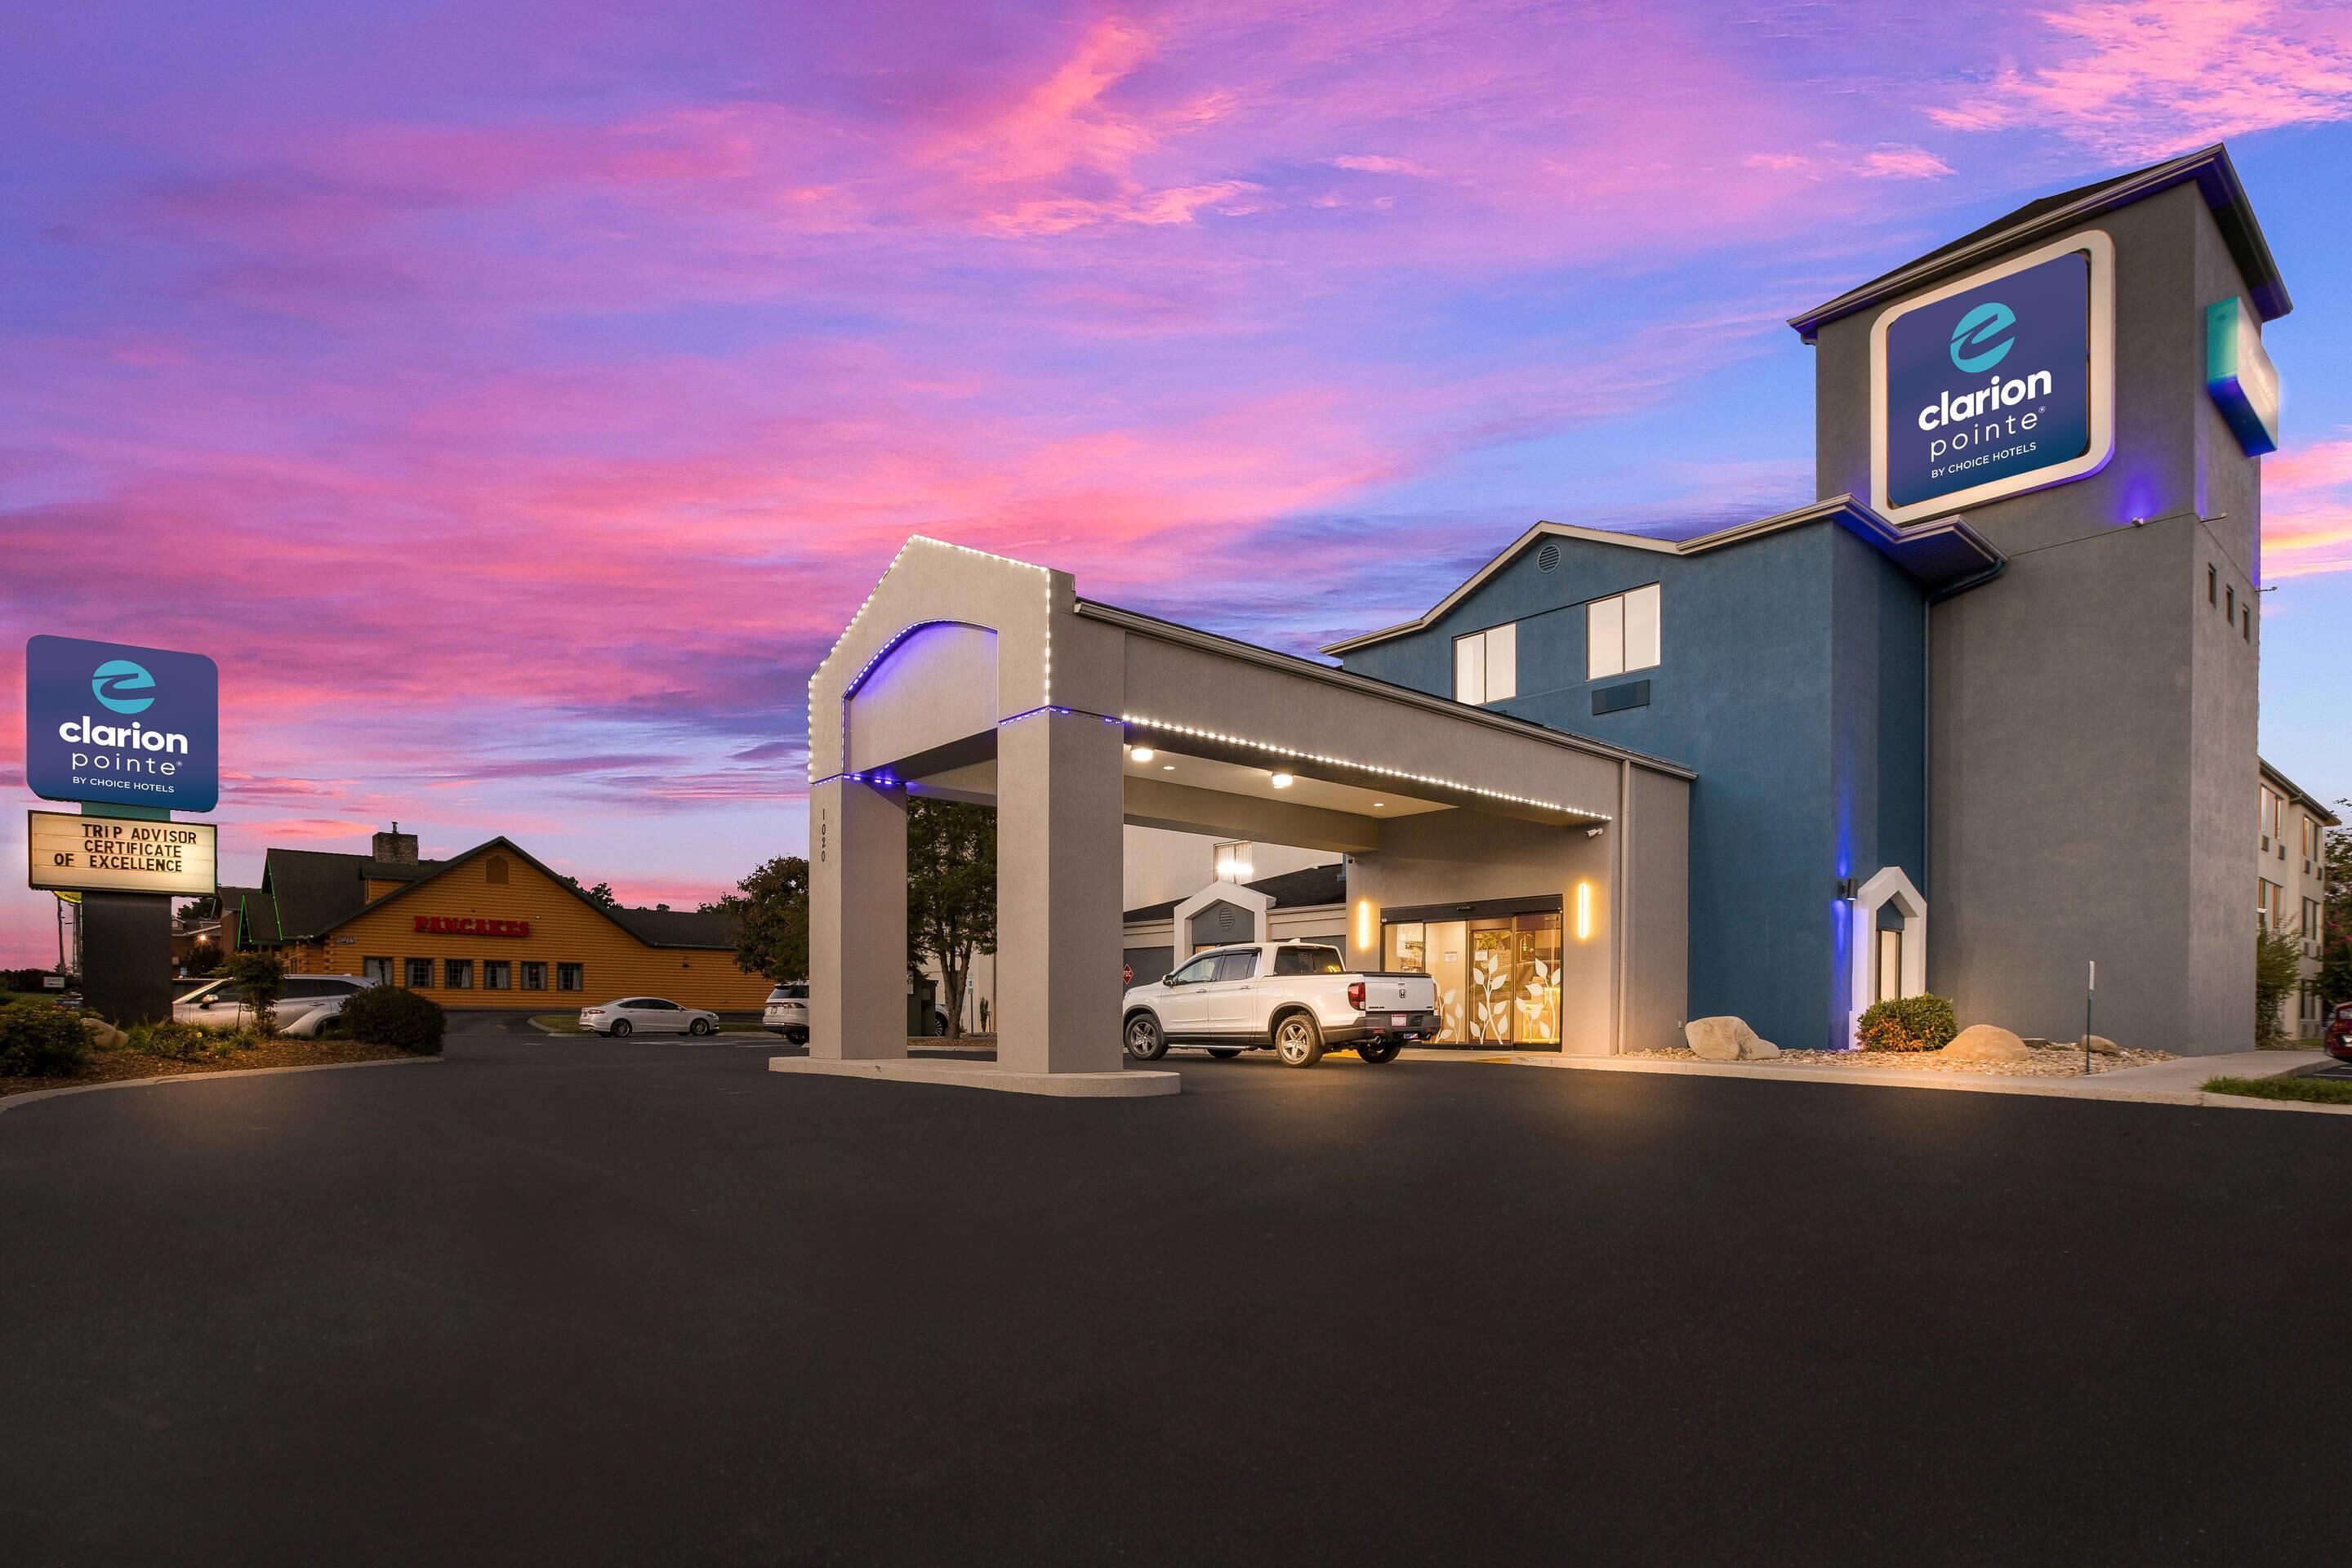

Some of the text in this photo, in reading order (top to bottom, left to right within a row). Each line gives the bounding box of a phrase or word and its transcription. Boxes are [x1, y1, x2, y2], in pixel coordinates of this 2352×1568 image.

[1918, 370, 2051, 430] clarion
[1931, 442, 2037, 479] BY CHOICE HOTELS
[59, 715, 188, 754] clarion
[73, 777, 175, 793] BY CHOICE HOTELS
[82, 823, 197, 844] TRIP ADVISOR
[84, 840, 181, 858] CERTIFICATE
[54, 853, 182, 872] OF EXCELLENCE
[414, 915, 529, 938] PANCAKES
